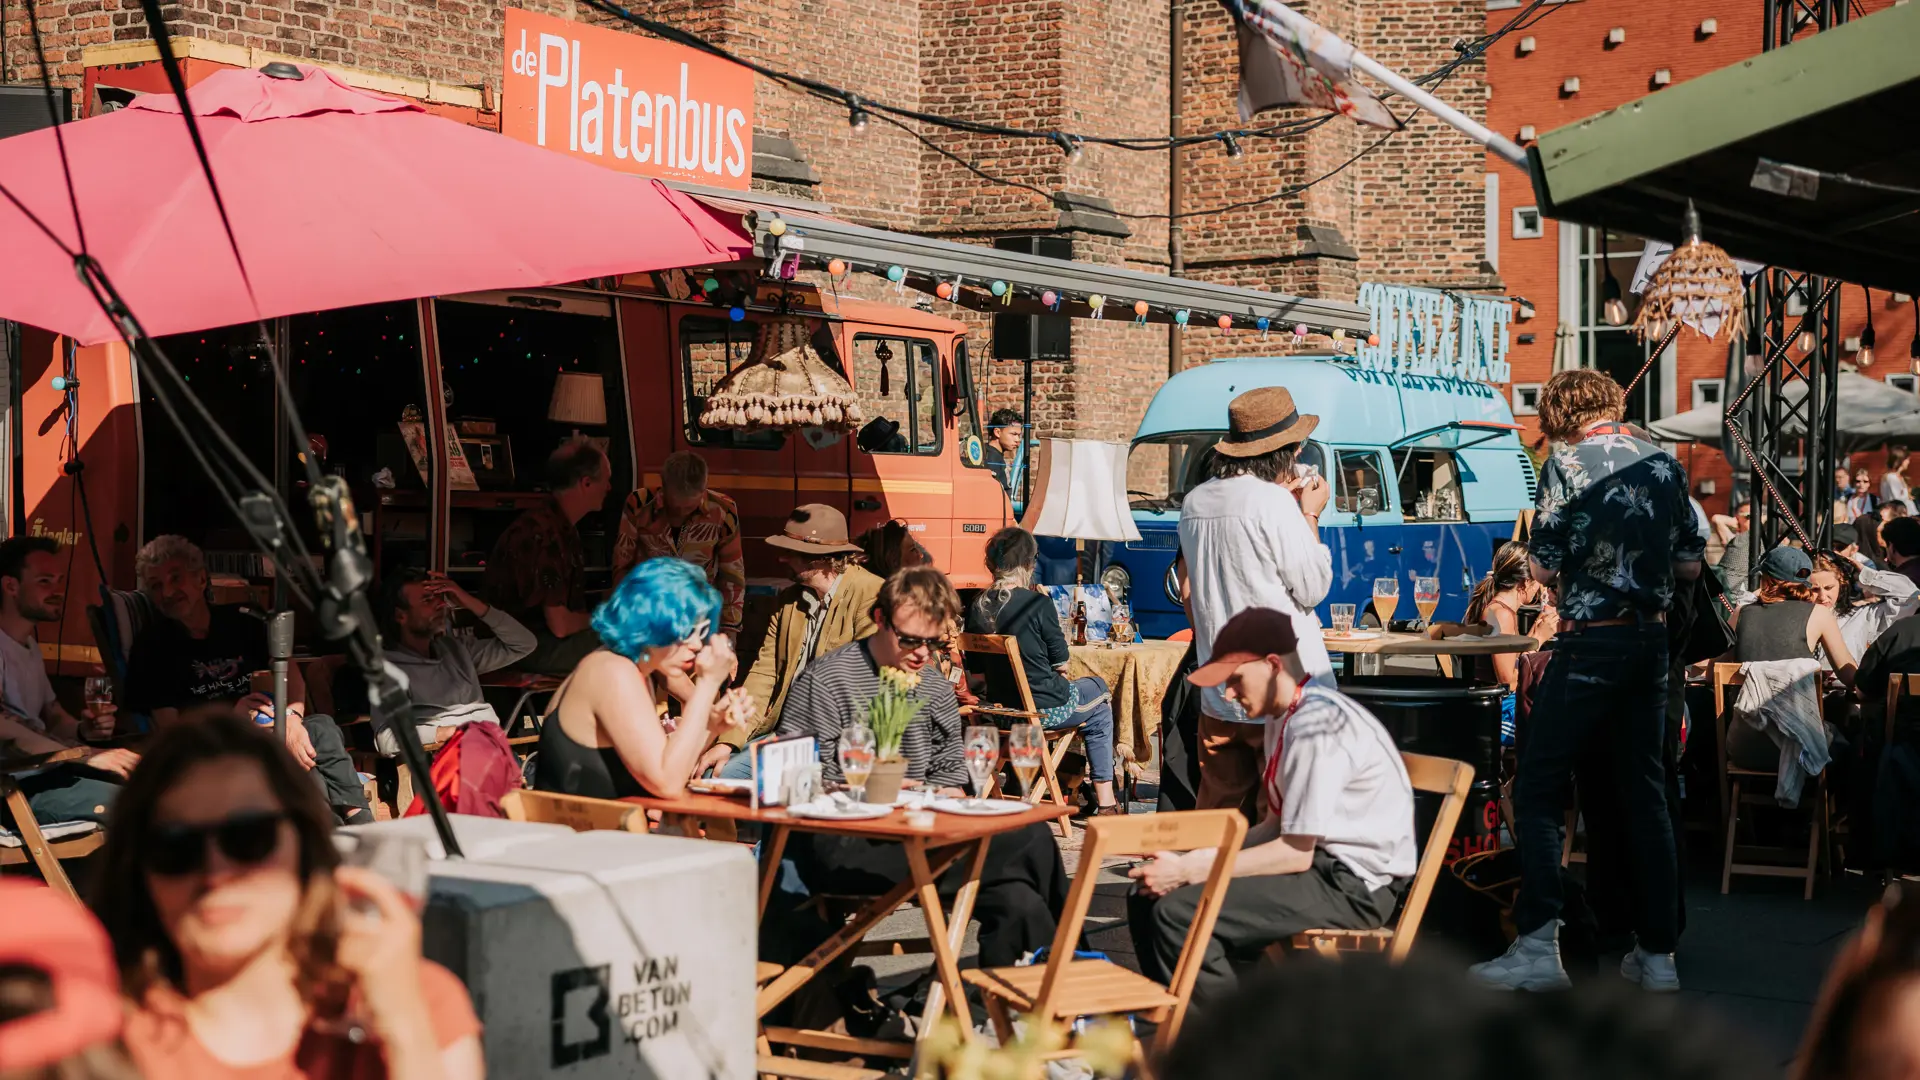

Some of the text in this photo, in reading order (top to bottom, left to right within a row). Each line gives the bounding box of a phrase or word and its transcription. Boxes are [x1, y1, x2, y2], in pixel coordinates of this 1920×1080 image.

[511, 28, 747, 178] de Platenbus
[1356, 281, 1440, 377] COFFEE
[1455, 296, 1513, 384] JUICE
[617, 980, 694, 1019] BETON
[633, 954, 680, 985] VAN
